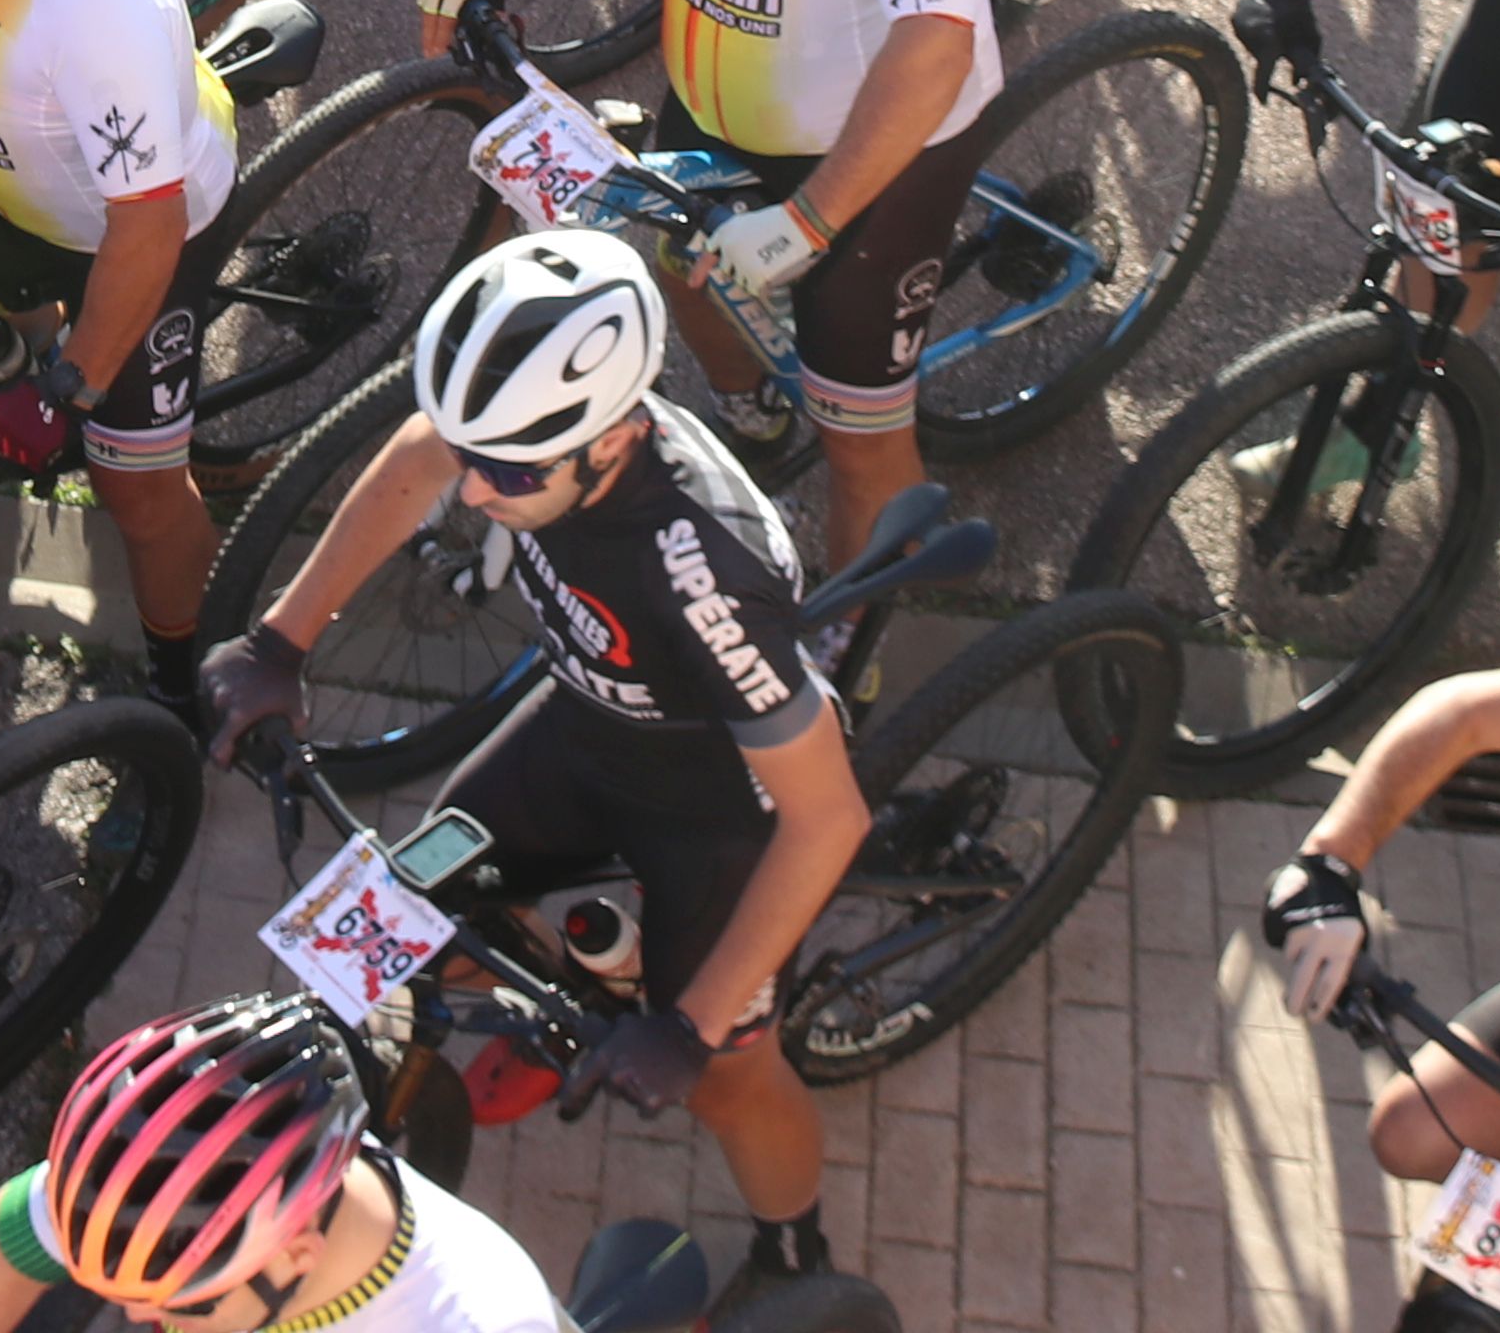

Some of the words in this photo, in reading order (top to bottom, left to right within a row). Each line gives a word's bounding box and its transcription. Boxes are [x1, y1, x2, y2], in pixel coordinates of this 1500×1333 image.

[740, 19, 782, 43] UNE
[525, 135, 579, 206] 7158
[655, 518, 791, 714] SUPÉRATE
[331, 902, 418, 987] 6759
